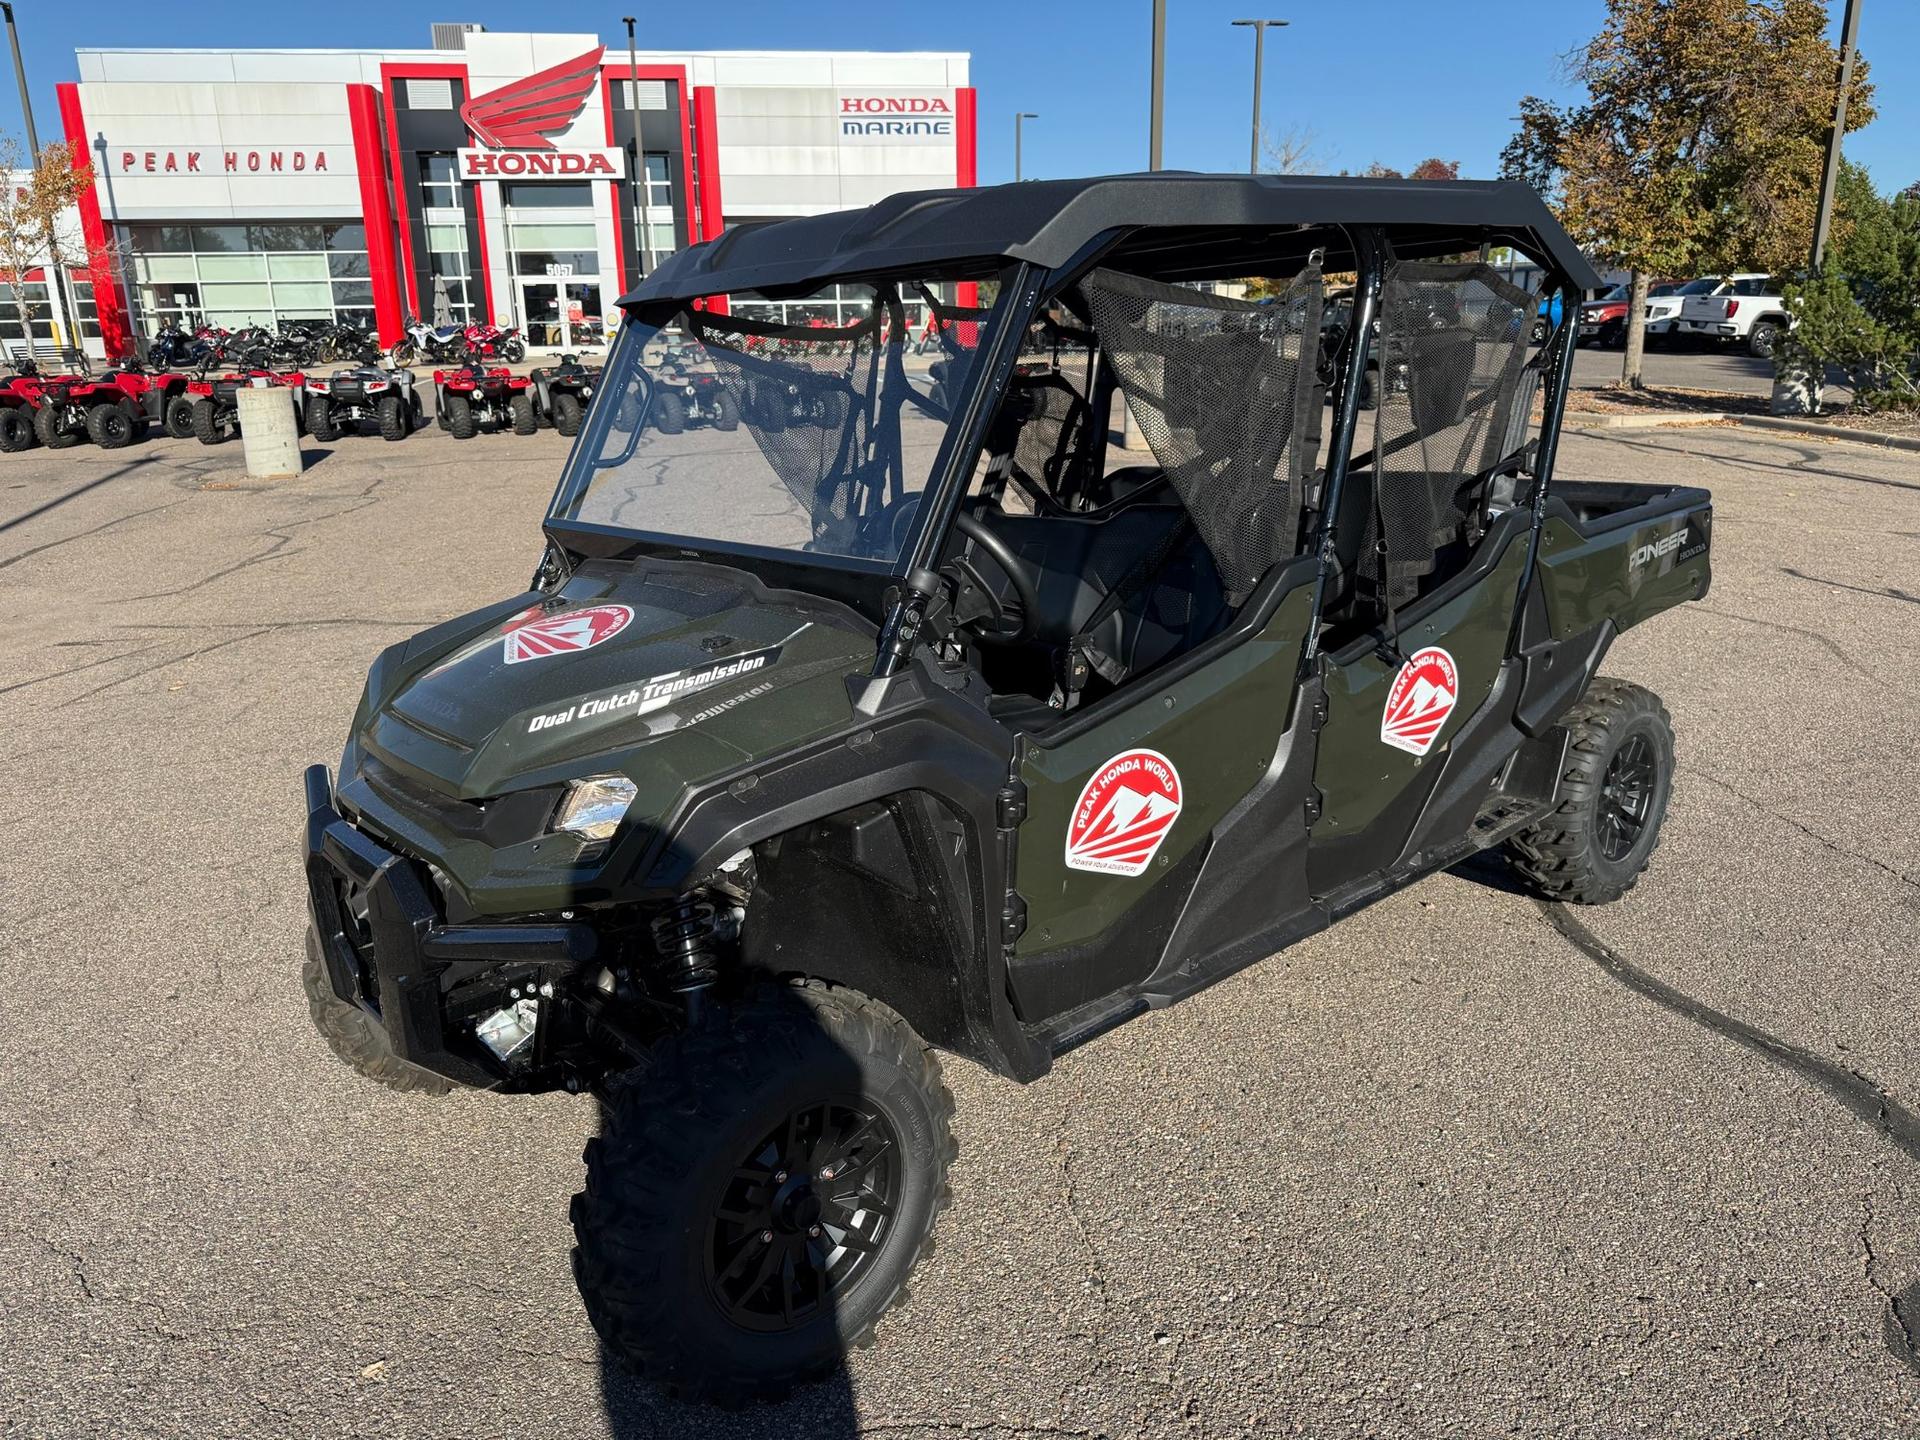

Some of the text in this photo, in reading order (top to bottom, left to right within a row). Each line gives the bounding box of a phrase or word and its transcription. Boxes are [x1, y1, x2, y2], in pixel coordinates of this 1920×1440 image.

[841, 98, 952, 113] HONDA
[122, 151, 328, 172] PEAK HONDA
[465, 153, 616, 175] HONDA
[545, 263, 573, 277] 5057
[1390, 654, 1454, 709] PEAK HONDA WORLD
[528, 656, 766, 733] Dual Clutch Transmission
[1077, 758, 1174, 829] PEAK HONDA WORLD
